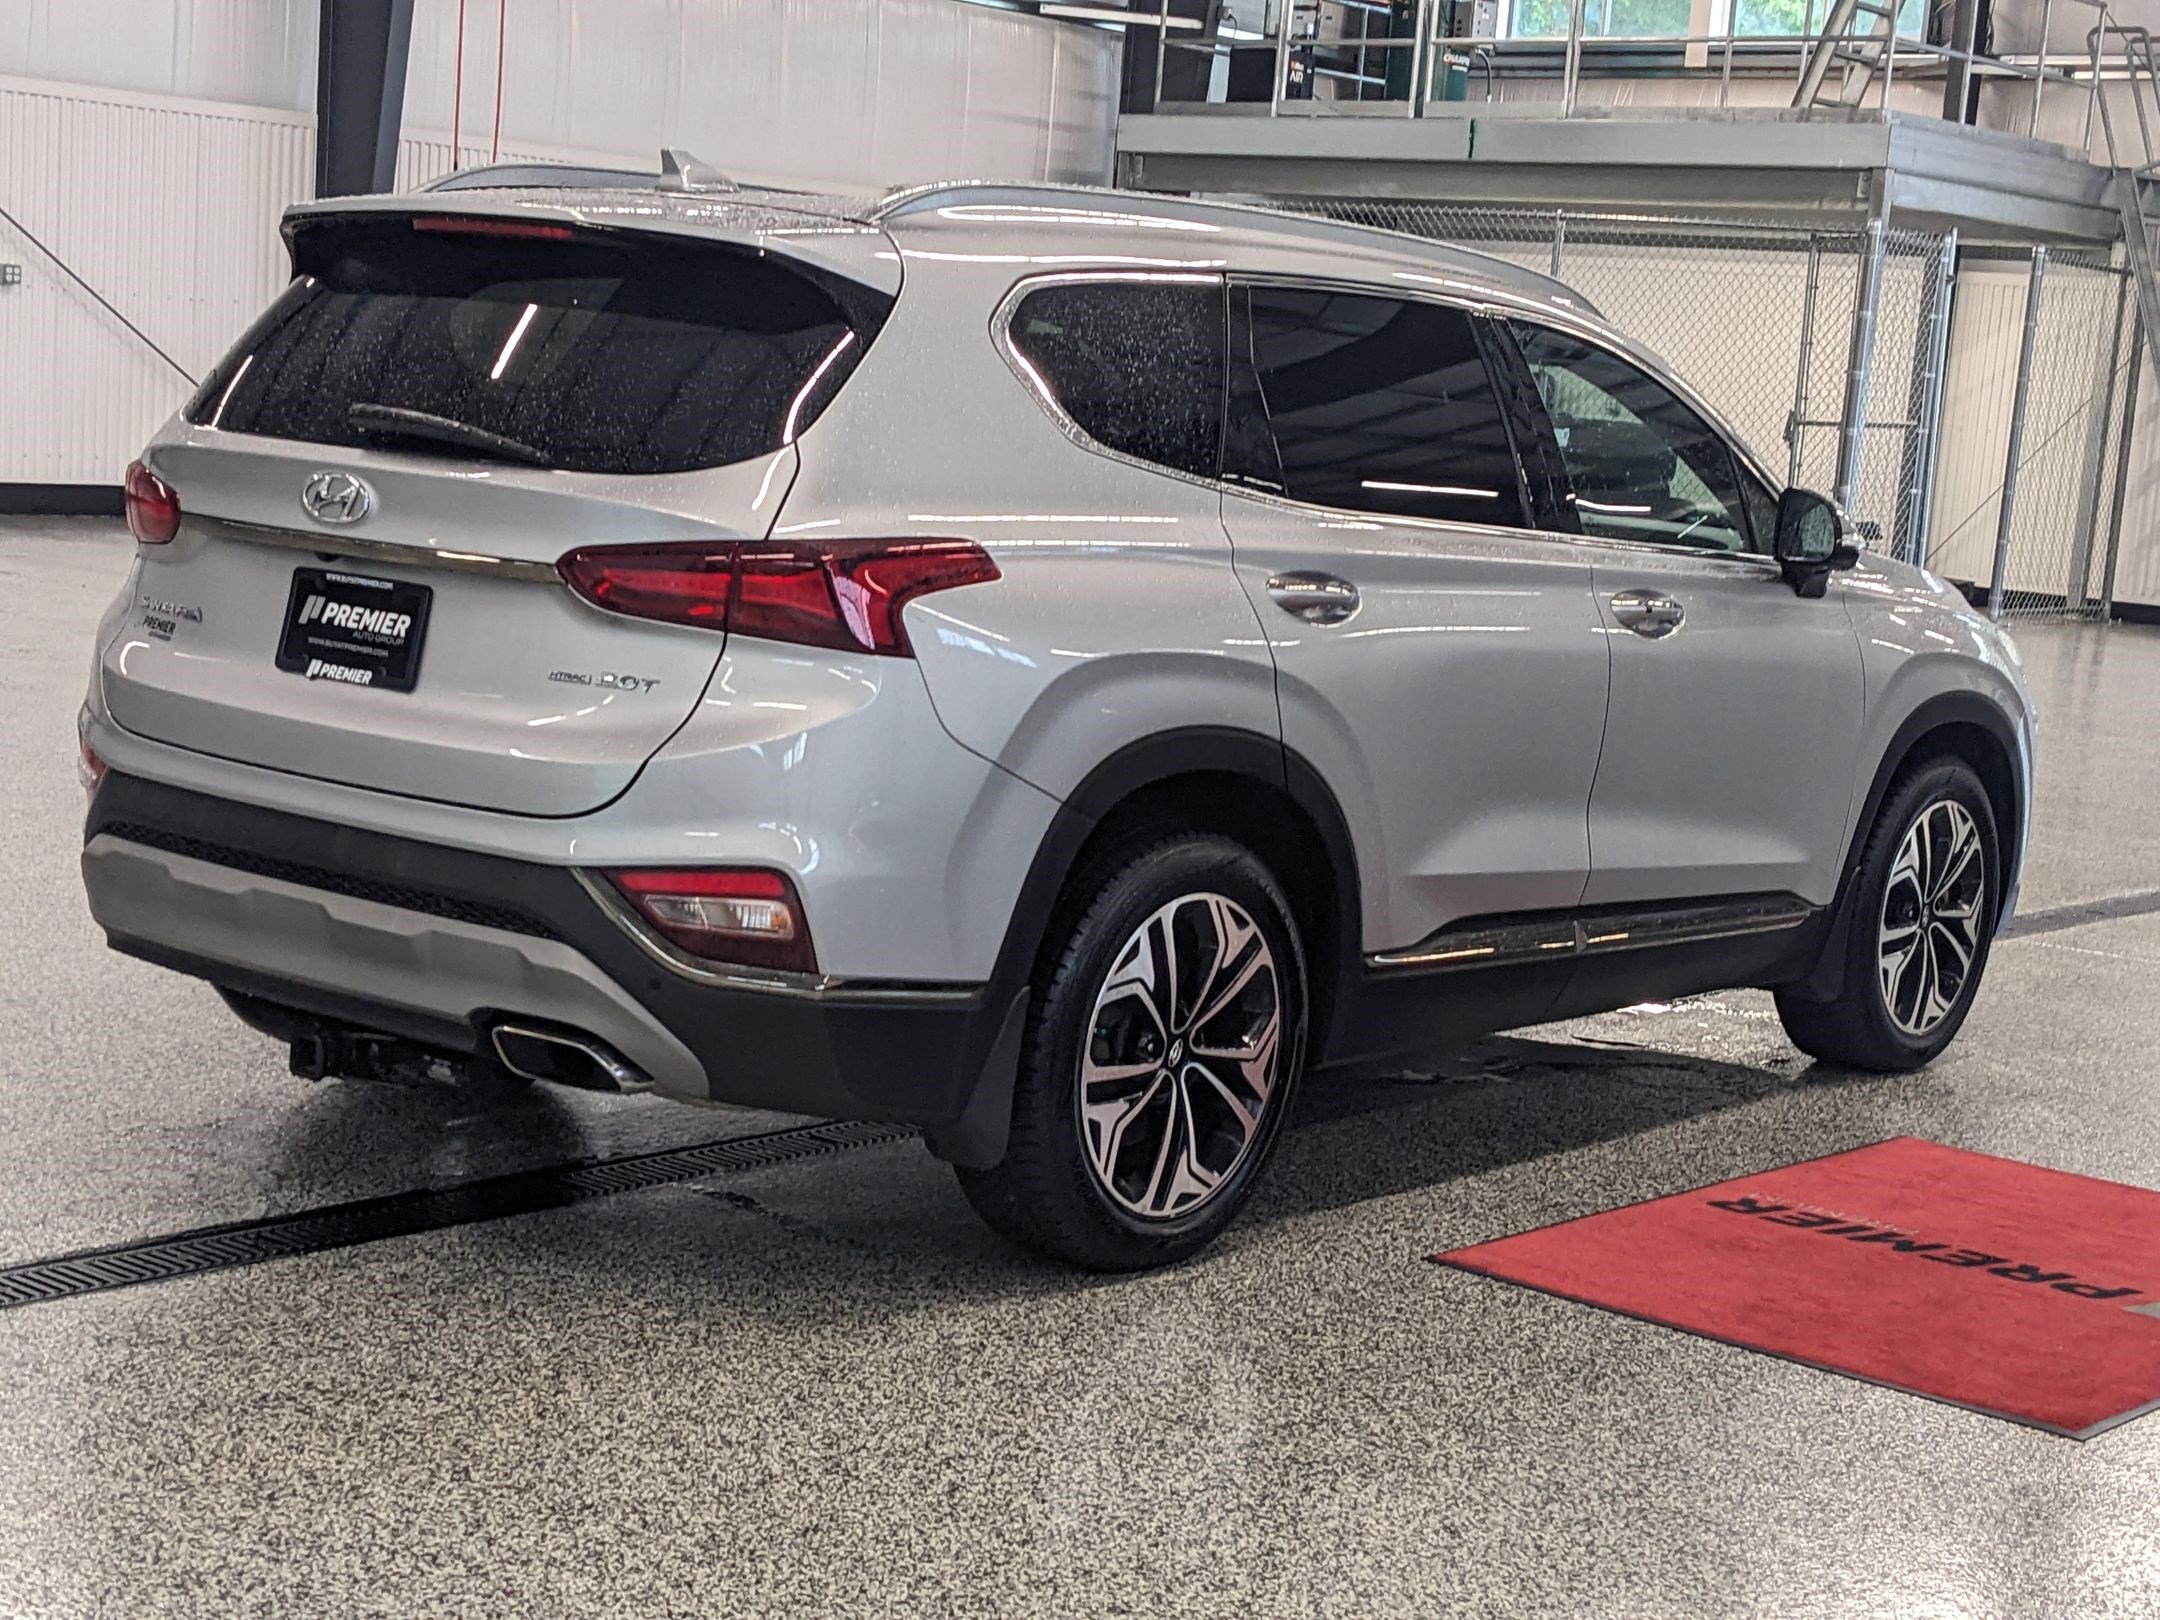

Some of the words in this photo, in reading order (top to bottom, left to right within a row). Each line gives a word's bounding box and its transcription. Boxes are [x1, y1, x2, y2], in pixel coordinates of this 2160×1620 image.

[320, 601, 411, 638] PREMIER
[352, 630, 374, 642] AUTO
[374, 634, 405, 646] GROUP
[320, 662, 373, 685] PREMIER
[1706, 1197, 2144, 1299] PREMIER
